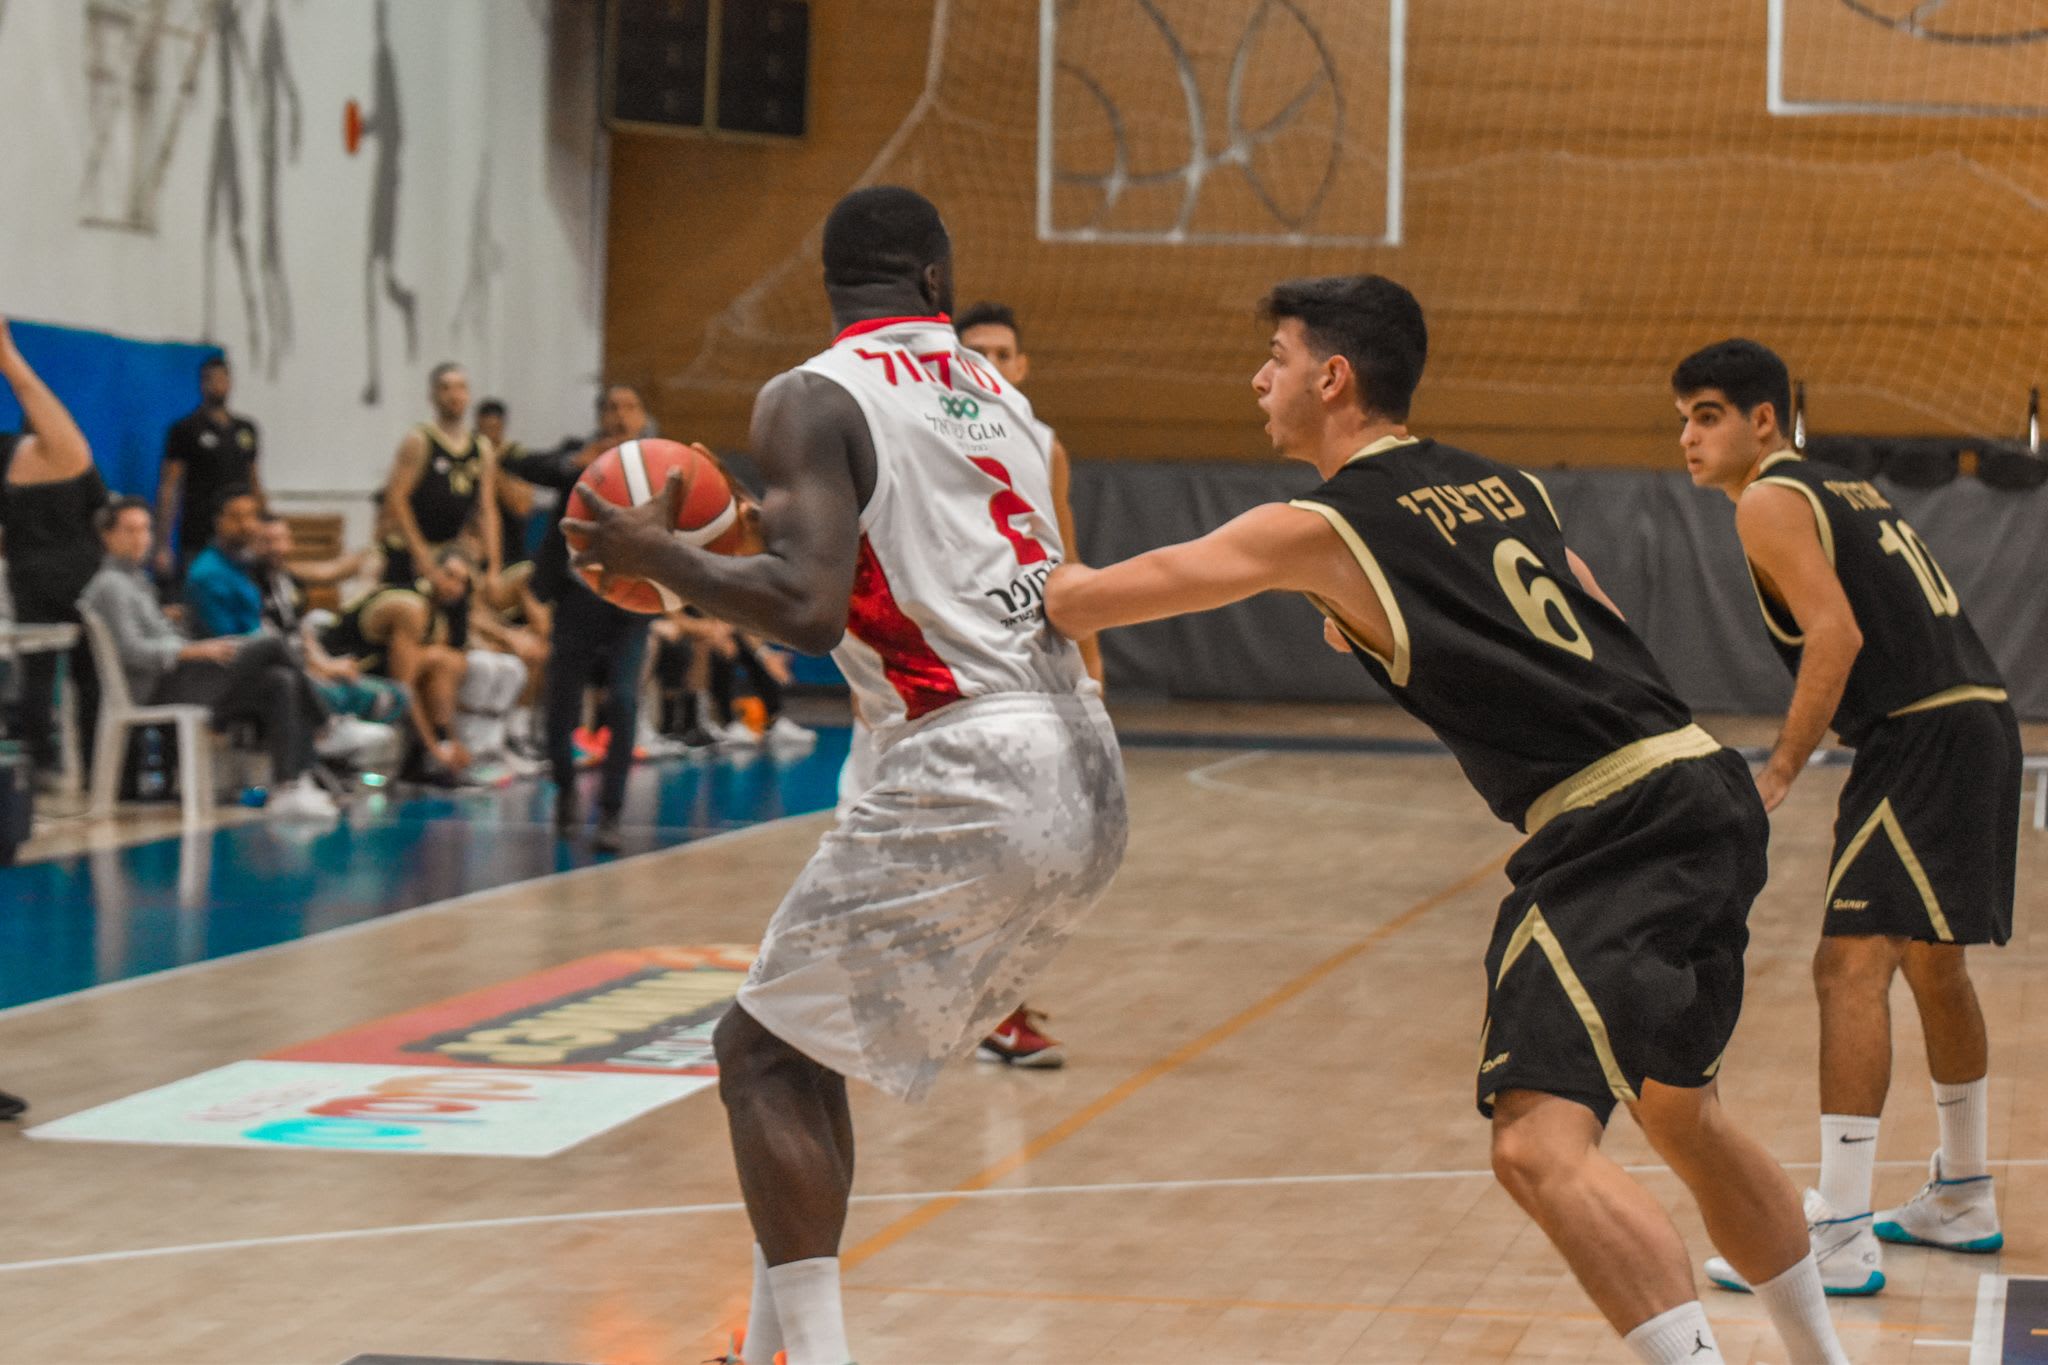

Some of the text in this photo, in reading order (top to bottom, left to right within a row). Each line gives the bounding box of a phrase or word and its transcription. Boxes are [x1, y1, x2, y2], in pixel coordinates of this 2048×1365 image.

[967, 422, 1007, 441] GLM
[965, 454, 1048, 566] 2
[1396, 475, 1527, 547] פרצקי
[1492, 536, 1595, 662] 6
[1877, 518, 1960, 618] 10
